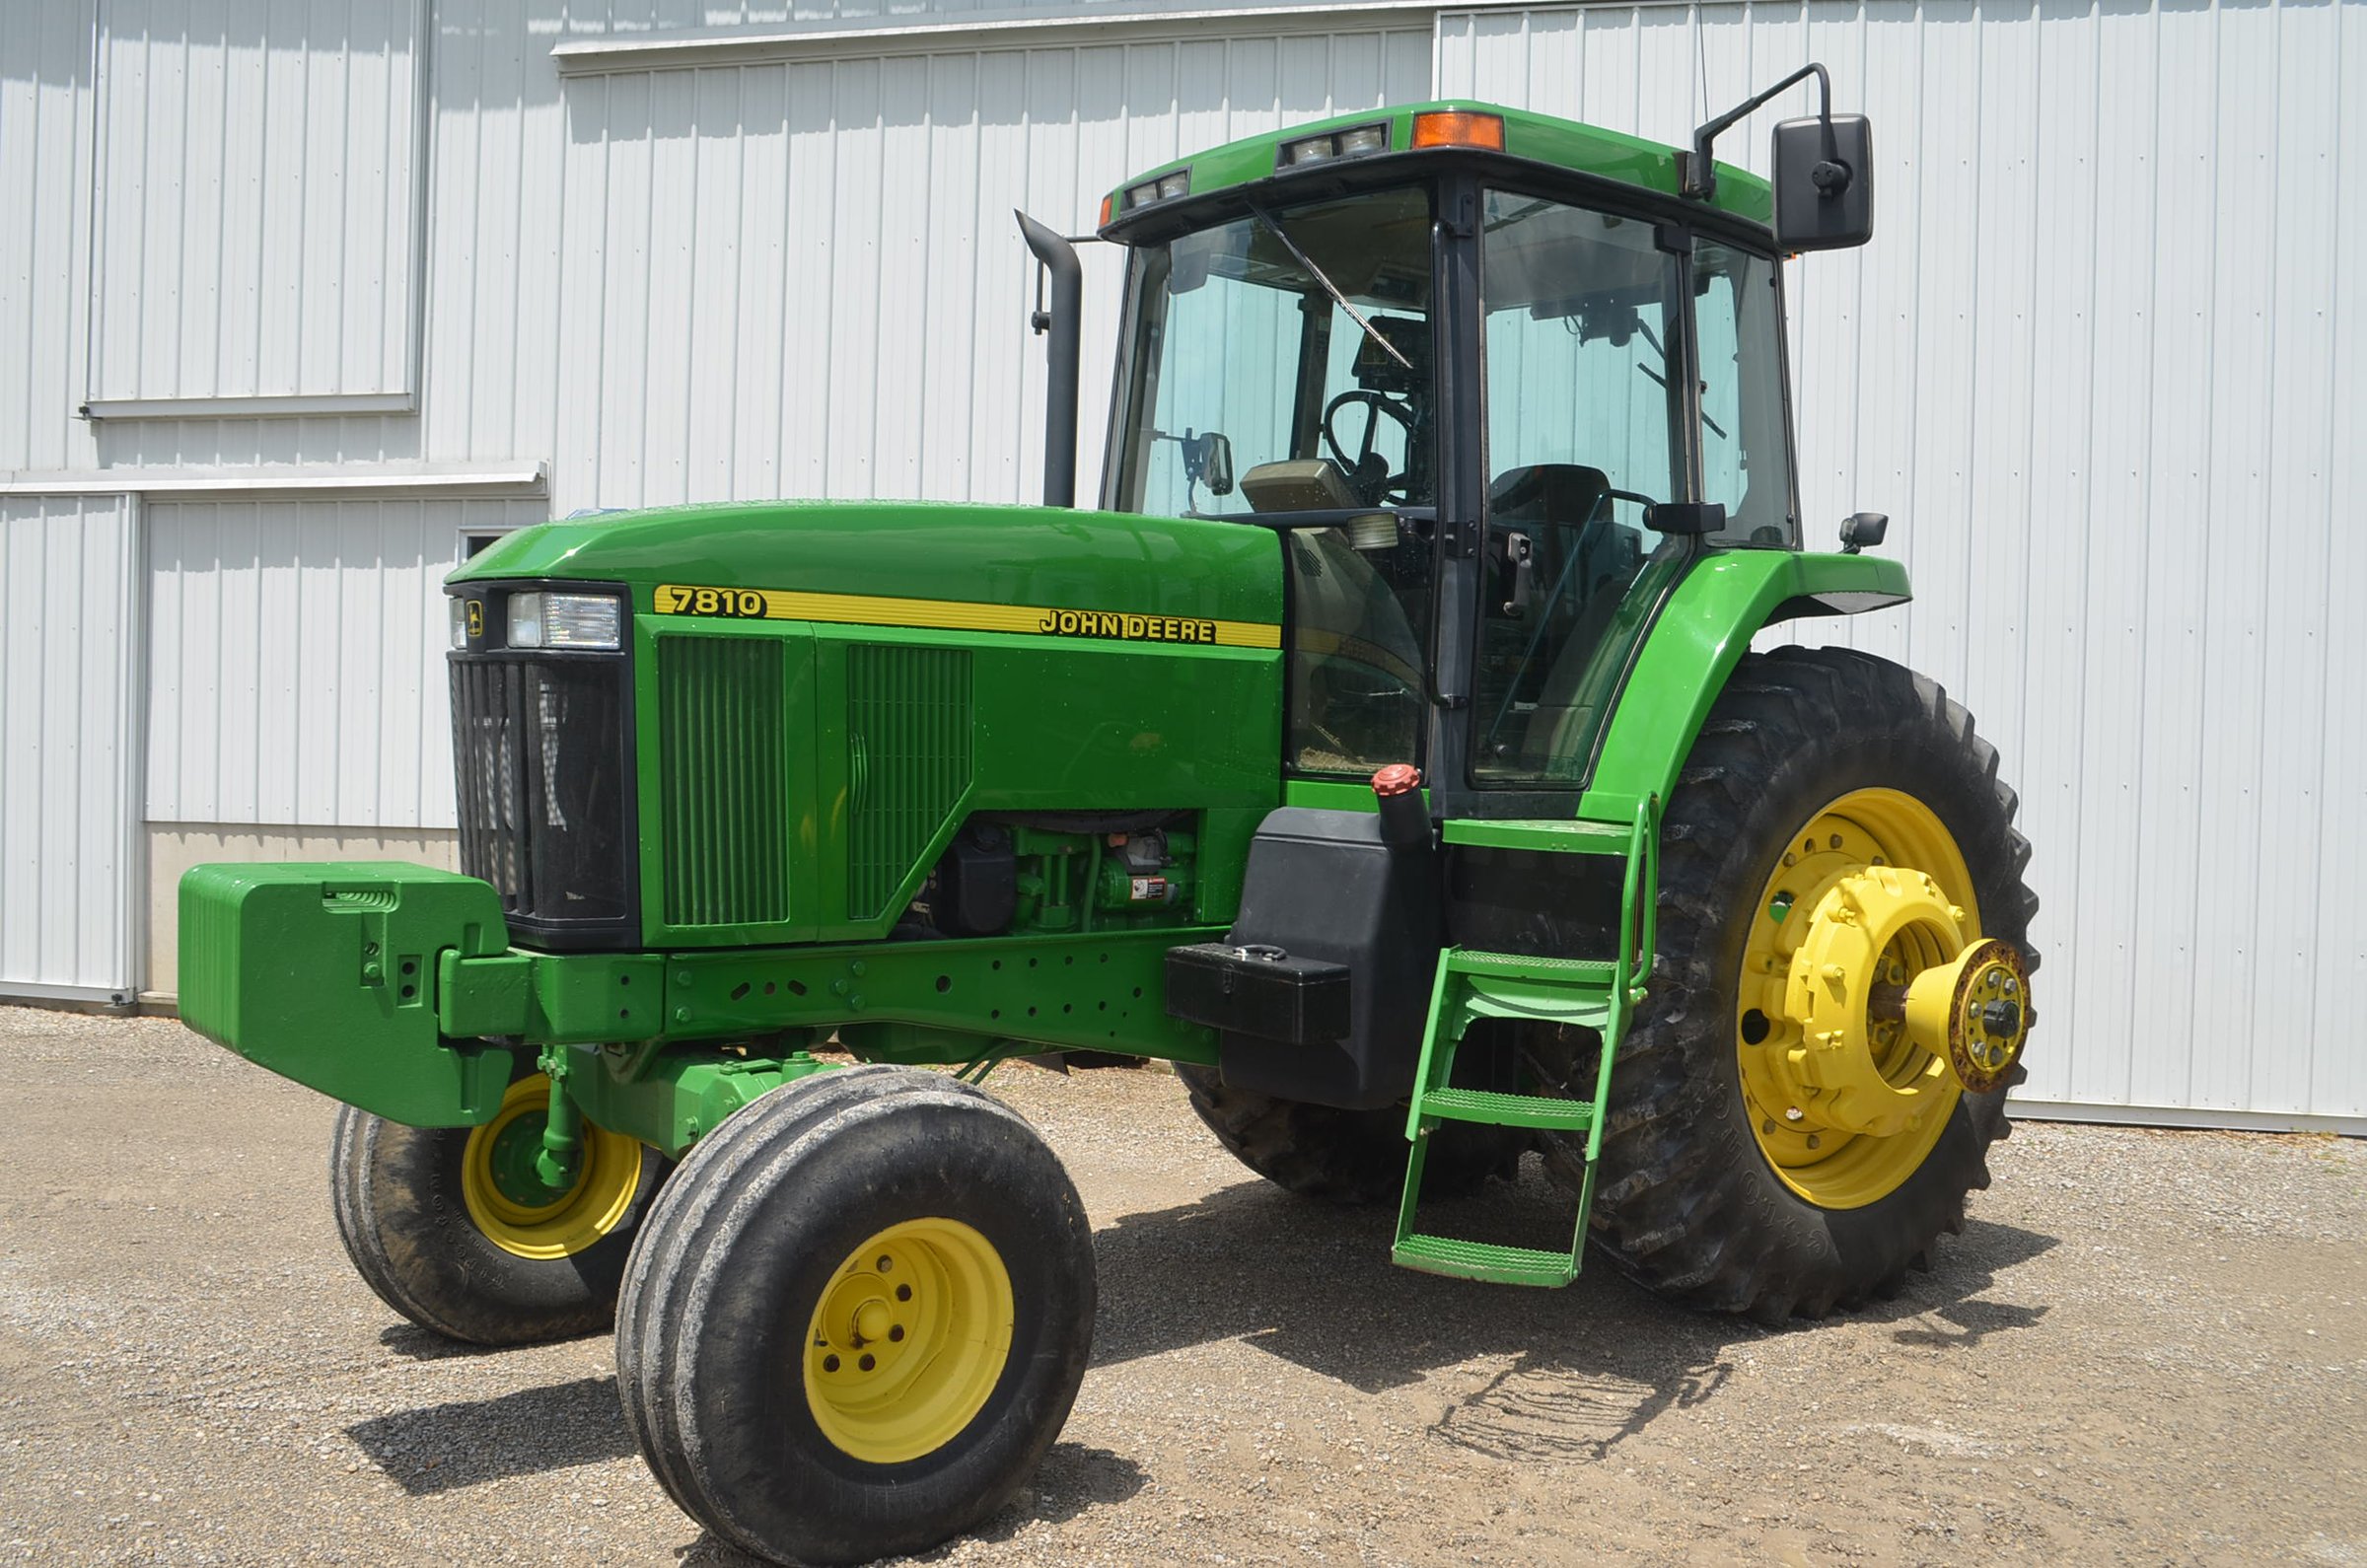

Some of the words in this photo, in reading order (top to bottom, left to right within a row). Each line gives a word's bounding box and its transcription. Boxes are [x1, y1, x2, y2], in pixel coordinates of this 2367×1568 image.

[671, 587, 767, 616] 7810
[1040, 610, 1121, 636] JOHN
[1127, 616, 1216, 642] DEERE
